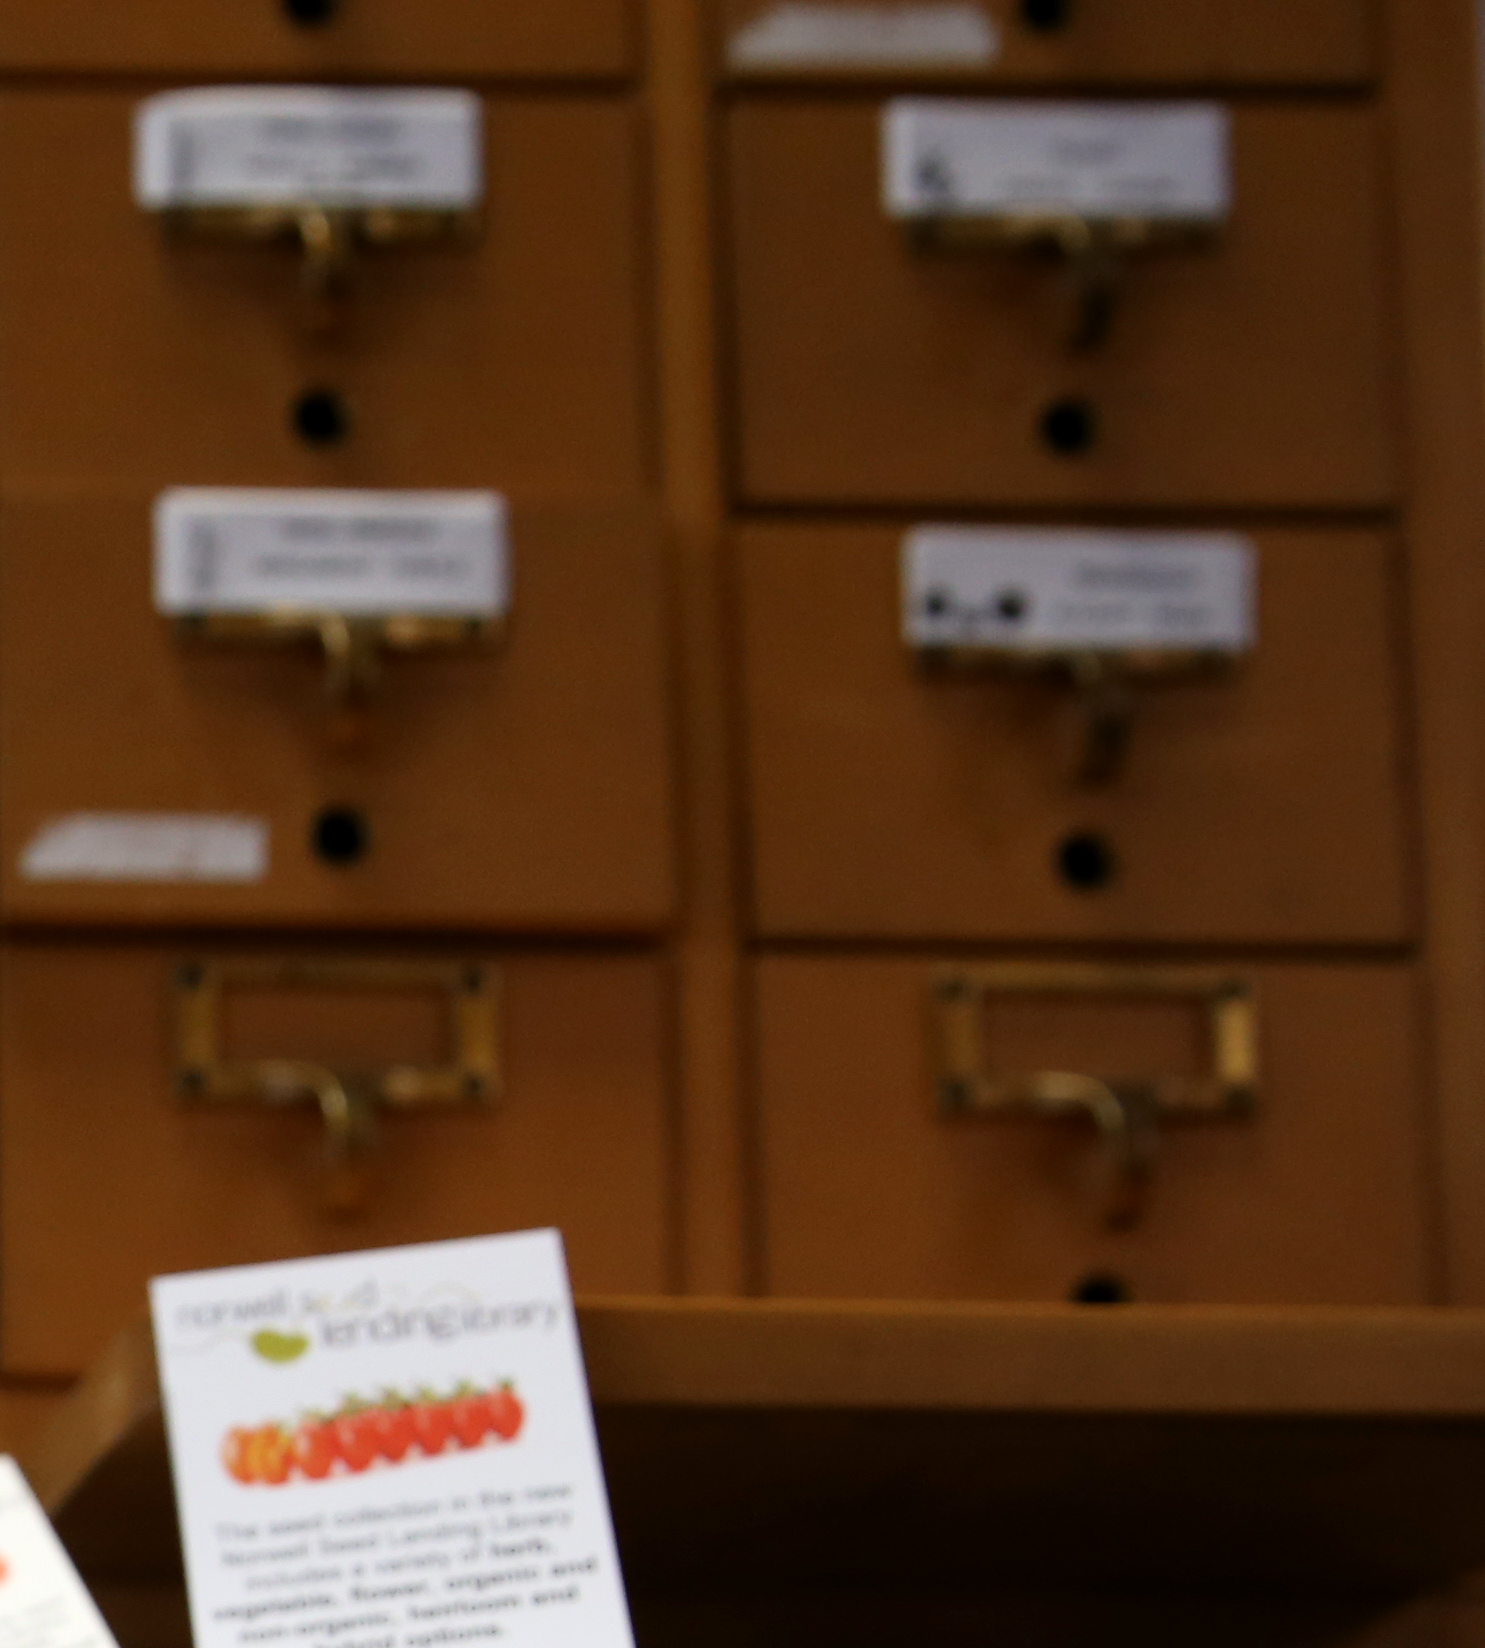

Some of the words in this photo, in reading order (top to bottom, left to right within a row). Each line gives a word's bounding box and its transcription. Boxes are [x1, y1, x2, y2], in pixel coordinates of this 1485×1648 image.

[444, 1567, 539, 1592] organic
[549, 1556, 599, 1578] and
[530, 1585, 580, 1607] and
